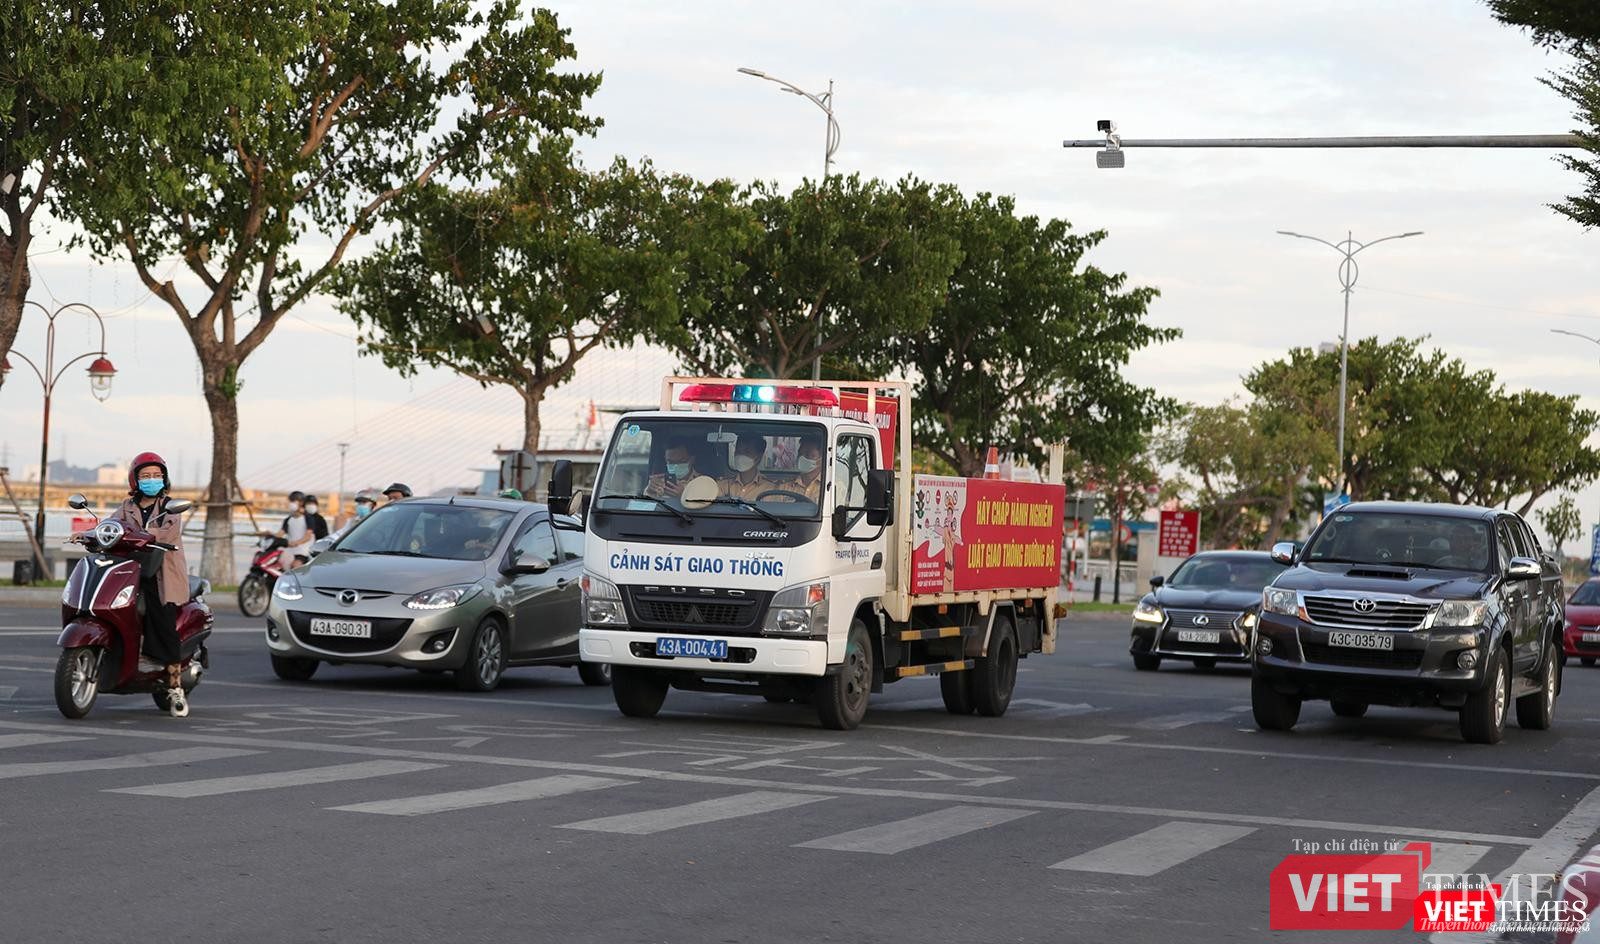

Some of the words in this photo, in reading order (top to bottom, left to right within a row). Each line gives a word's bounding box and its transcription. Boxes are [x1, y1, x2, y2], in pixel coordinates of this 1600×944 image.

[992, 493, 1010, 526] CHẤP
[1010, 497, 1029, 527] HÀNH
[1028, 499, 1054, 528] NGHIÊM
[743, 530, 789, 538] CANTER
[835, 550, 851, 559] TRAFFIC
[857, 549, 869, 558] POLICE
[968, 538, 985, 574] LUẬT
[986, 543, 1002, 569] GIAO
[1002, 538, 1024, 568] THÔNG
[610, 549, 650, 570] CẢNH
[654, 553, 683, 572] SÁT
[688, 557, 723, 573] GIAO
[729, 557, 783, 577] THÔNG
[313, 620, 368, 636] 43A-090.31
[659, 639, 724, 657] 43A-004.41
[1330, 632, 1392, 649] 43C-035.79
